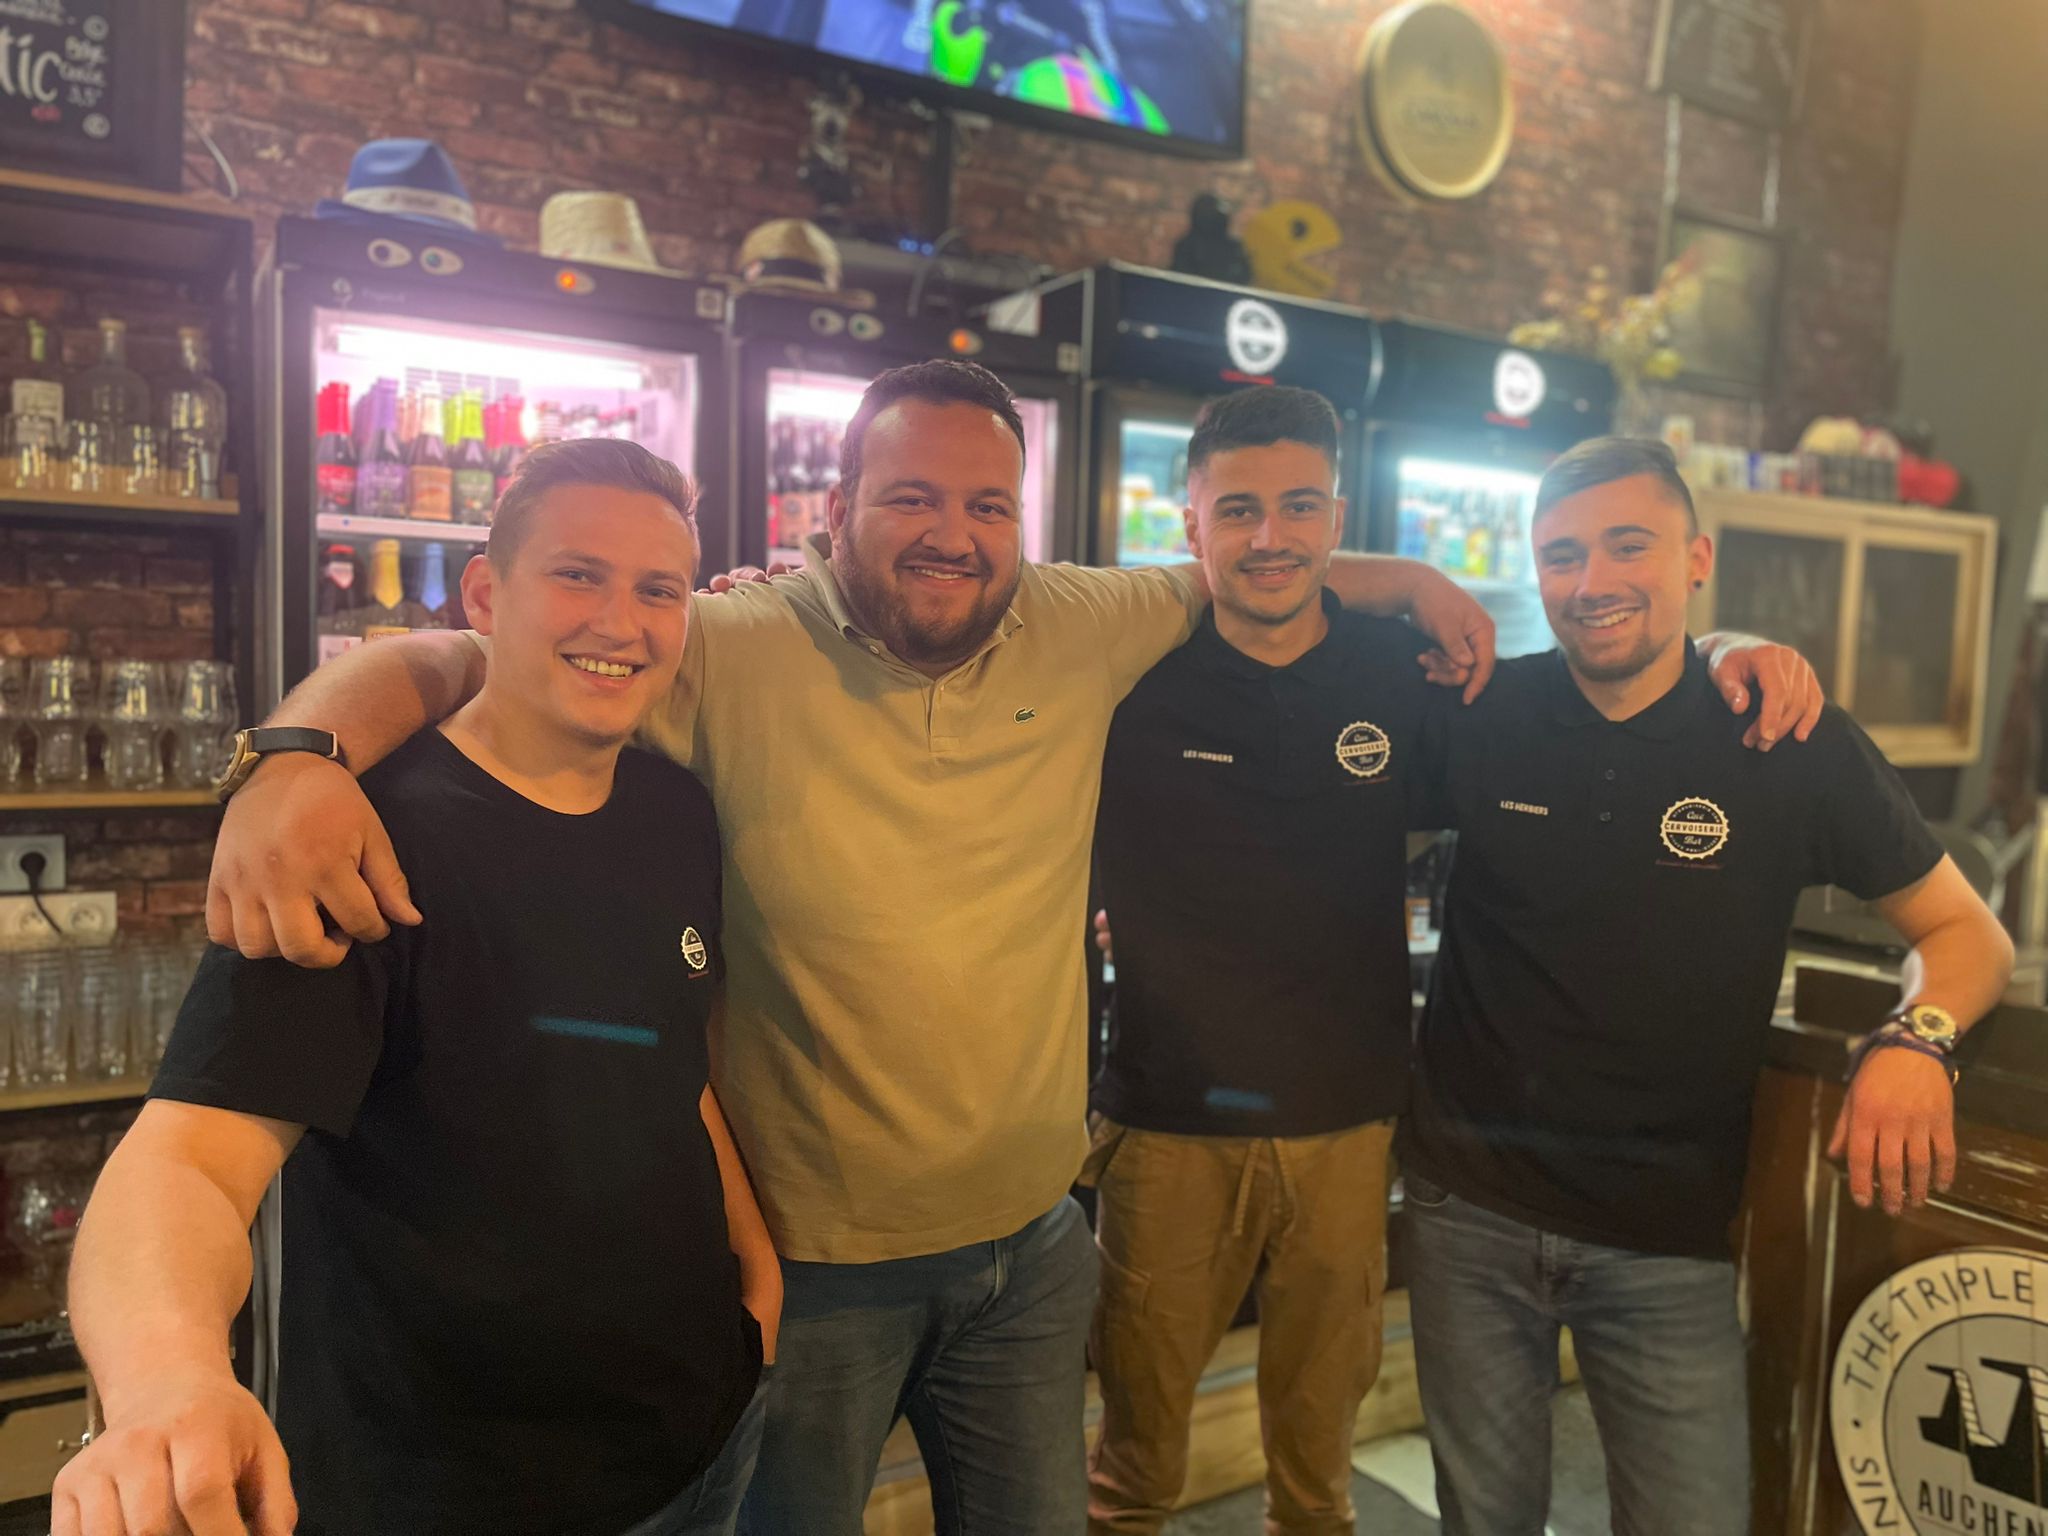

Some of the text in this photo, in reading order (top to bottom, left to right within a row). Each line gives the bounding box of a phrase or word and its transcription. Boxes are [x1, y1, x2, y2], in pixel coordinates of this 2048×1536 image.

[1339, 742, 1387, 756] CERVOISERIE
[1500, 800, 1514, 810] LES
[1664, 822, 1724, 834] CERVOISERIE
[1844, 1266, 2034, 1390] THE TRIPLE
